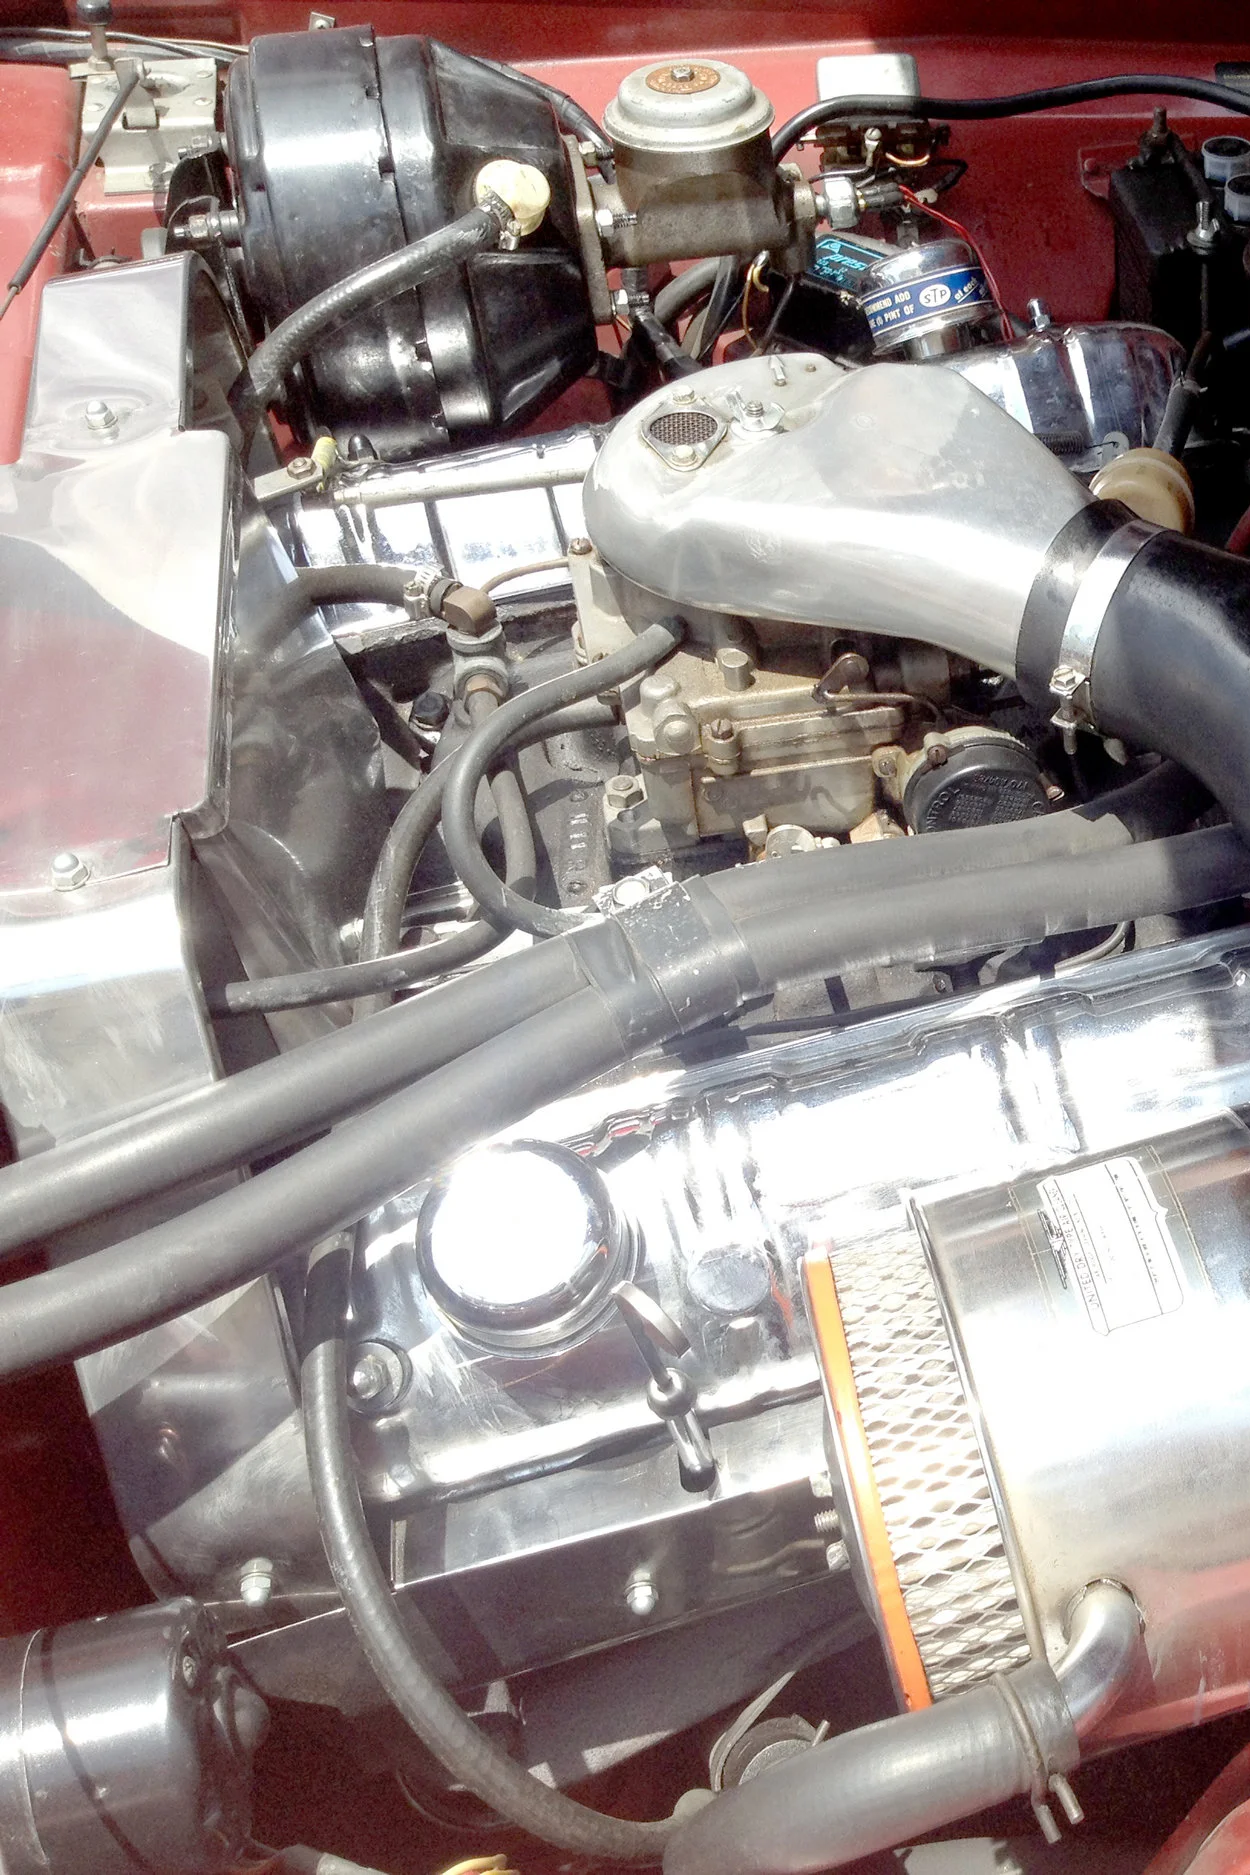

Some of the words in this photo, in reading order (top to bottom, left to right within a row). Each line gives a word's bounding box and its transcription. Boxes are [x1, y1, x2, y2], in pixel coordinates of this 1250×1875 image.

[893, 290, 912, 304] ADD
[883, 308, 901, 323] PINT
[902, 303, 916, 316] OF
[926, 786, 960, 830] ONTROL
[1070, 1251, 1087, 1270] DRY
[1078, 1272, 1101, 1310] UNITED
